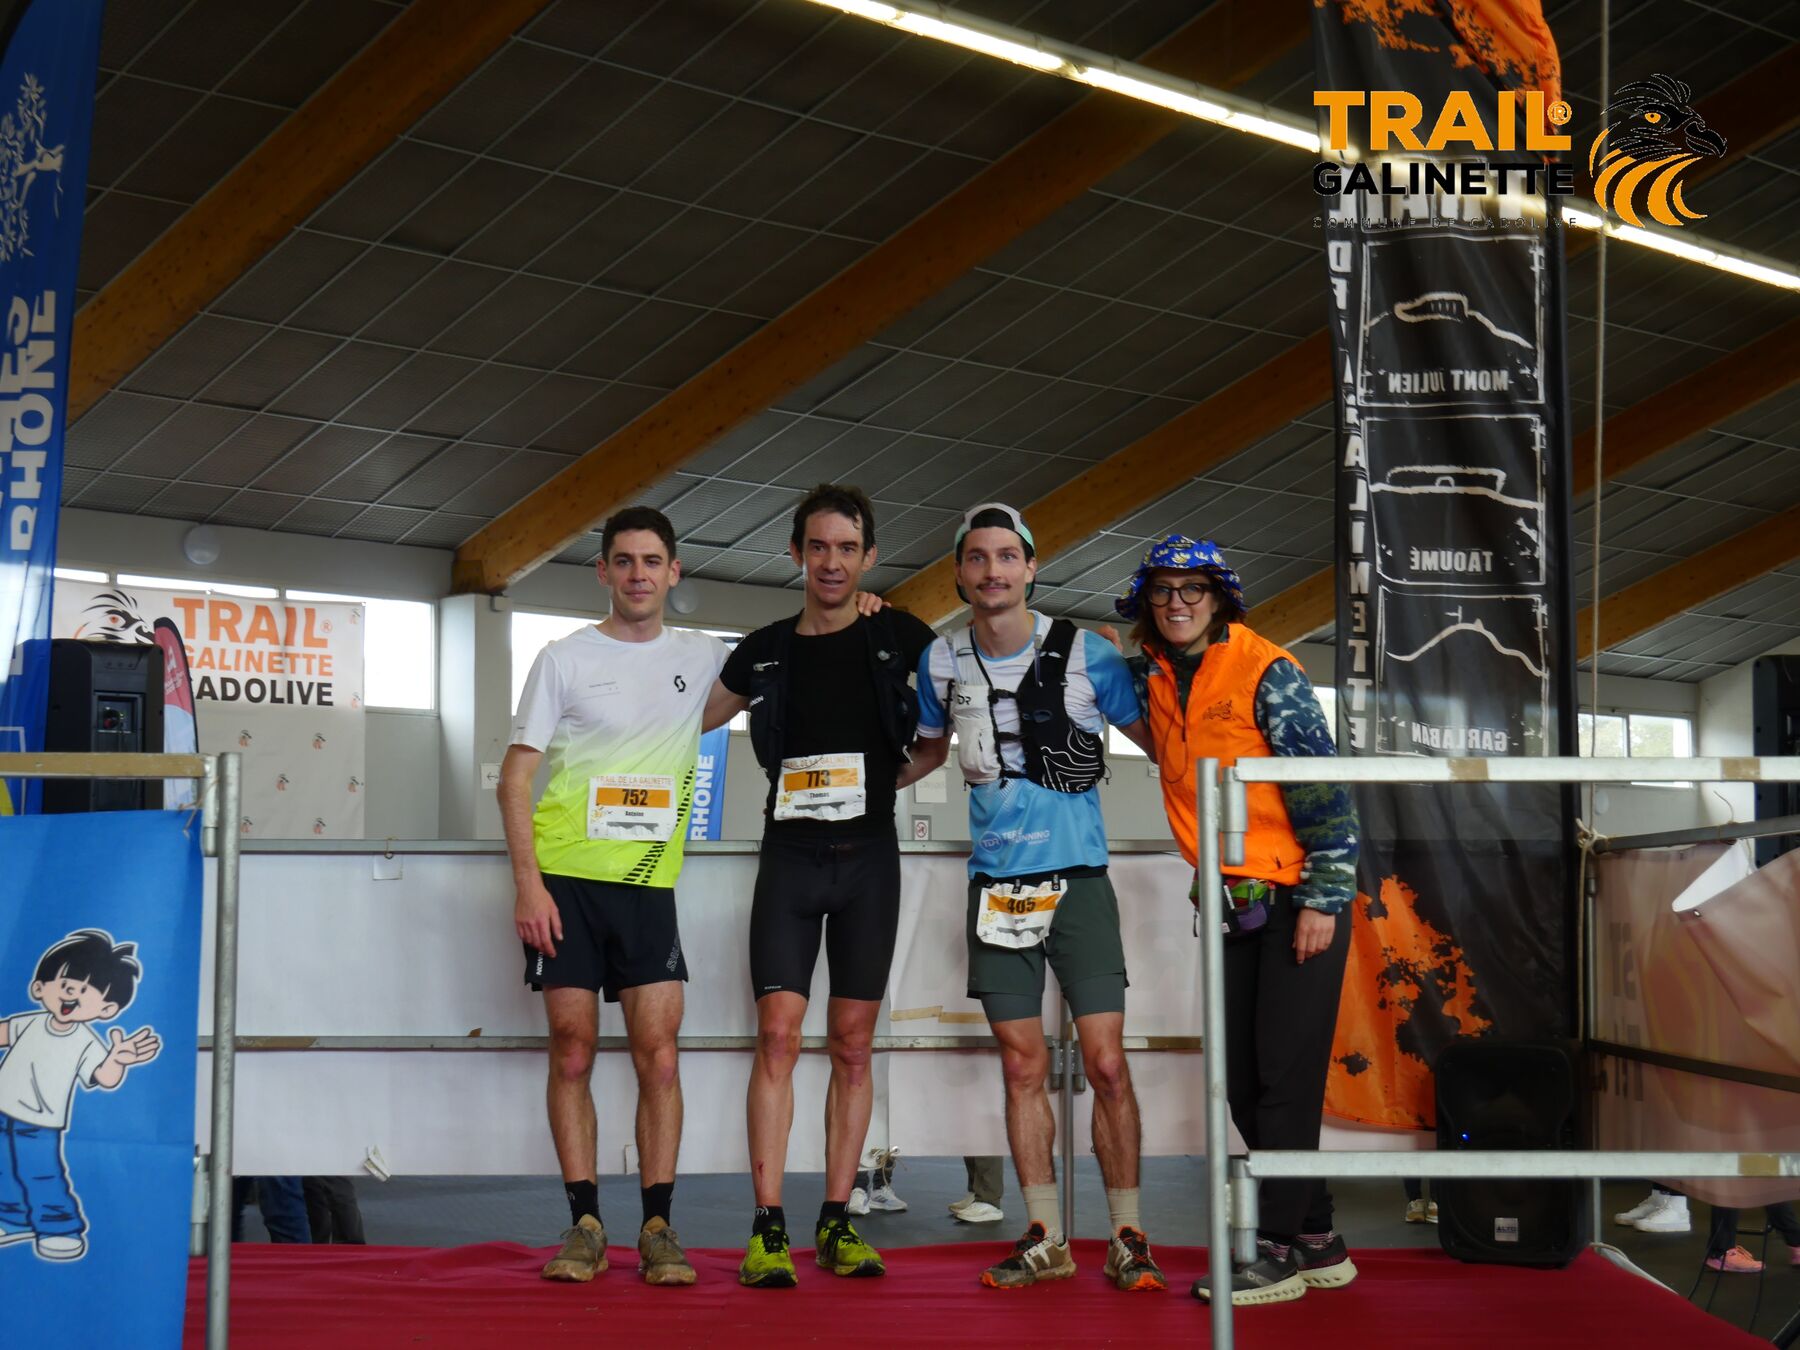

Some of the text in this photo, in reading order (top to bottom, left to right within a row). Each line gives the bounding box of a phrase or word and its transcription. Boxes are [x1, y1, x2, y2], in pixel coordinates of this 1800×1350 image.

[195, 675, 334, 707] ADOLIVE
[806, 769, 831, 788] 773
[622, 789, 649, 806] 752
[690, 753, 715, 841] RHONE
[1007, 897, 1036, 913] 405
